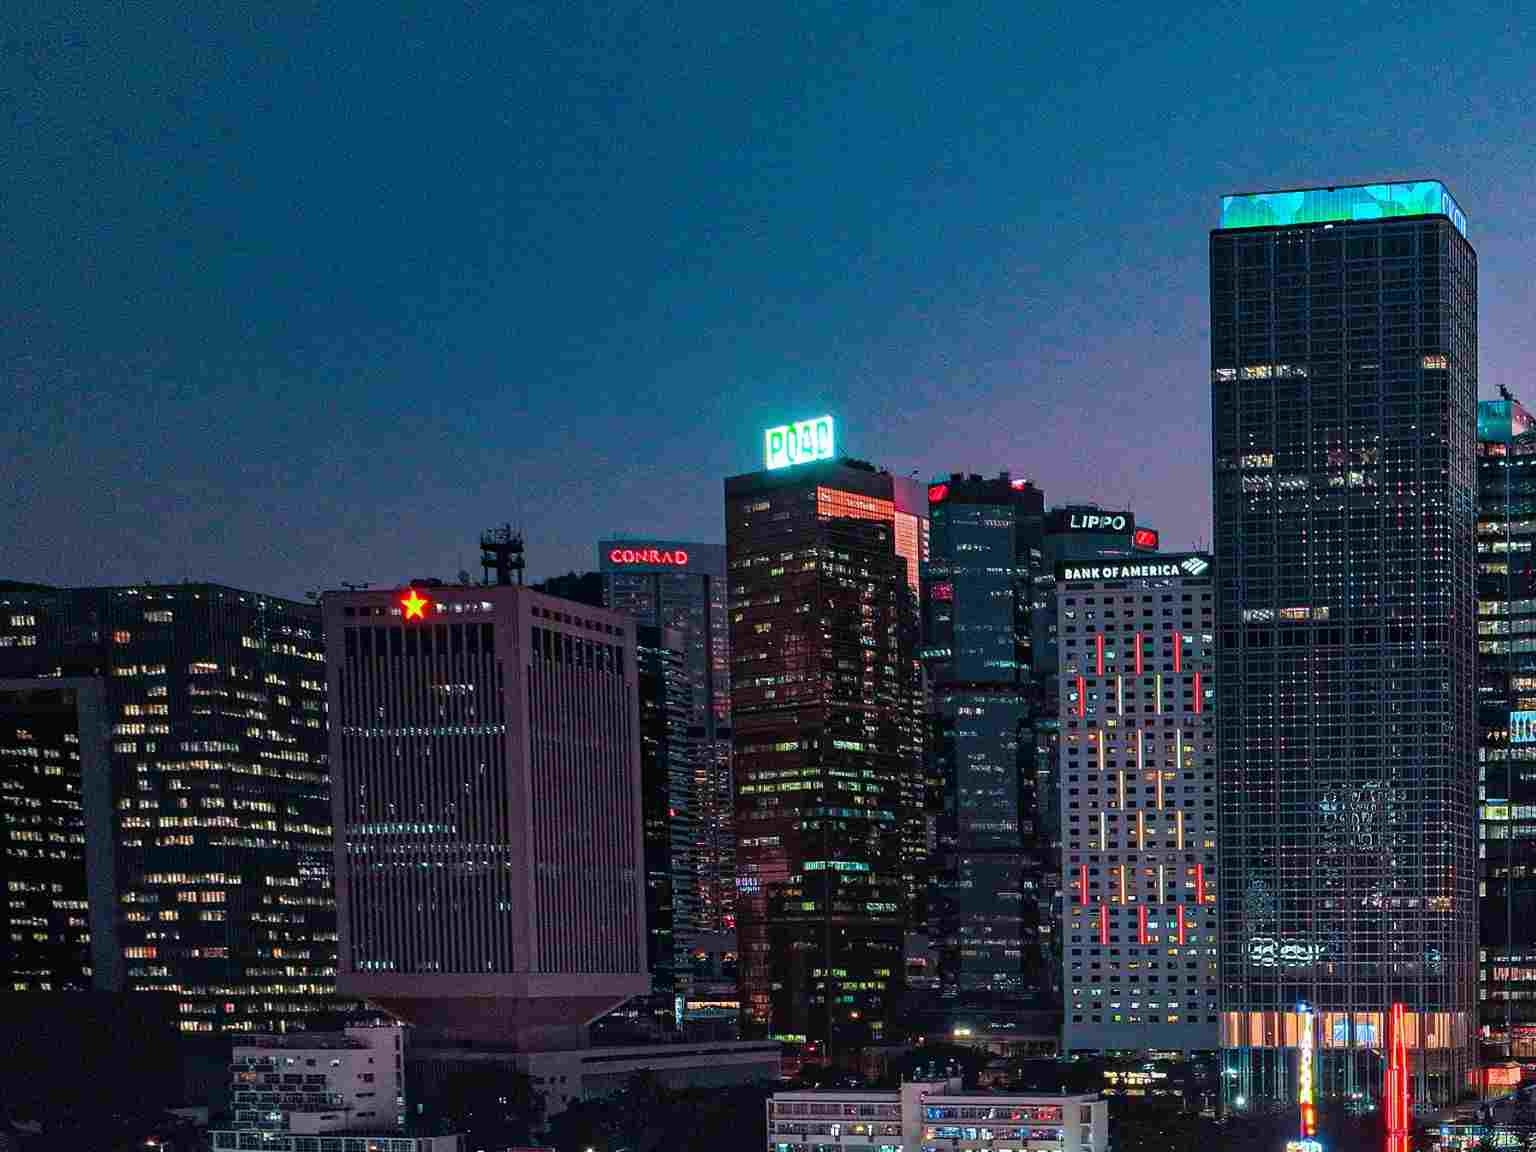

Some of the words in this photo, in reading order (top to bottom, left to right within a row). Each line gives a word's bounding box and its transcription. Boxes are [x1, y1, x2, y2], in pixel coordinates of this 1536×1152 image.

[1070, 515, 1126, 530] LIPPO
[610, 549, 688, 565] CONRAD
[1064, 567, 1100, 580] BANK
[1102, 566, 1119, 578] OF
[1121, 564, 1180, 577] AMERICA
